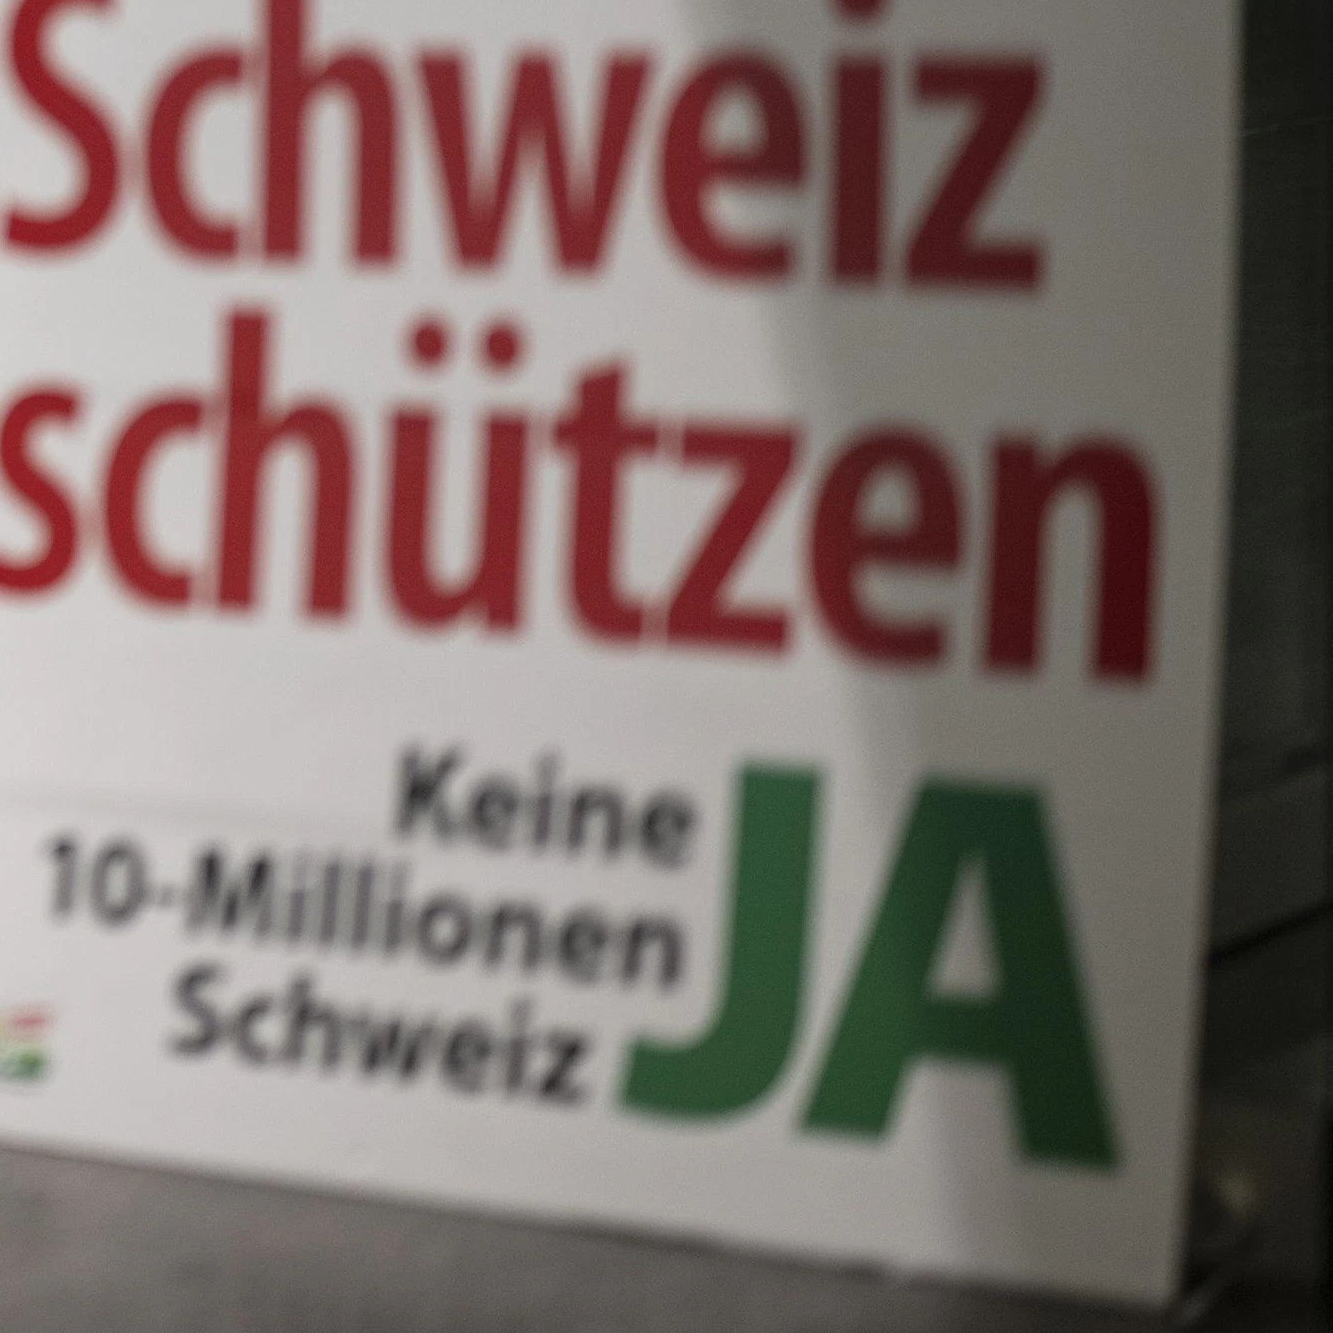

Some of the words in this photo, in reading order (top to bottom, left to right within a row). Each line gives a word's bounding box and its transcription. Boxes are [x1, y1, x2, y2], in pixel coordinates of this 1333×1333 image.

[396, 743, 698, 873] Keine
[47, 833, 686, 993] 10-Millionen
[617, 760, 1124, 1175] JA
[166, 961, 598, 1107] Schweiz
